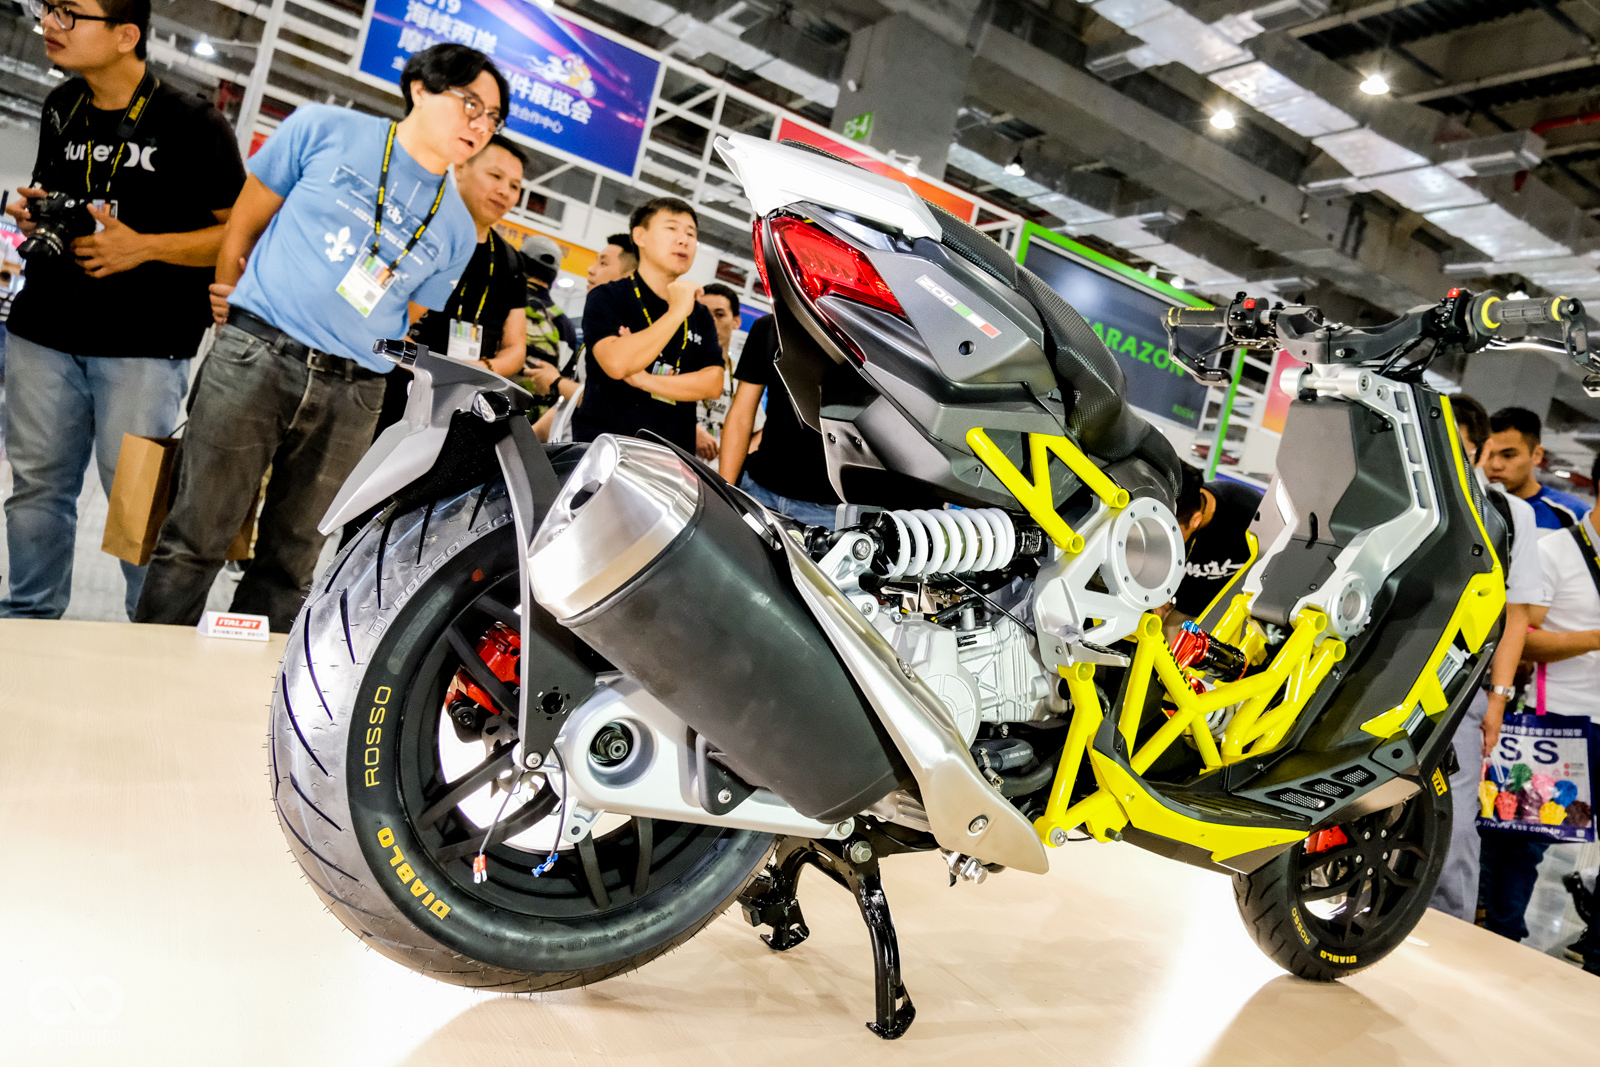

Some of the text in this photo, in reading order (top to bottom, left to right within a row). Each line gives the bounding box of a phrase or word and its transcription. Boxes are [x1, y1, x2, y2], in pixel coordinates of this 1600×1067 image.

[404, 1, 497, 54] 海峡两岸
[919, 277, 958, 307] 200
[1083, 316, 1188, 377] ARAZON
[218, 618, 260, 629] ITALJET
[364, 685, 392, 788] ROSSO
[377, 826, 452, 921] DIABLO
[1291, 907, 1311, 945] ROSSO
[1320, 949, 1358, 964] DIABLO
